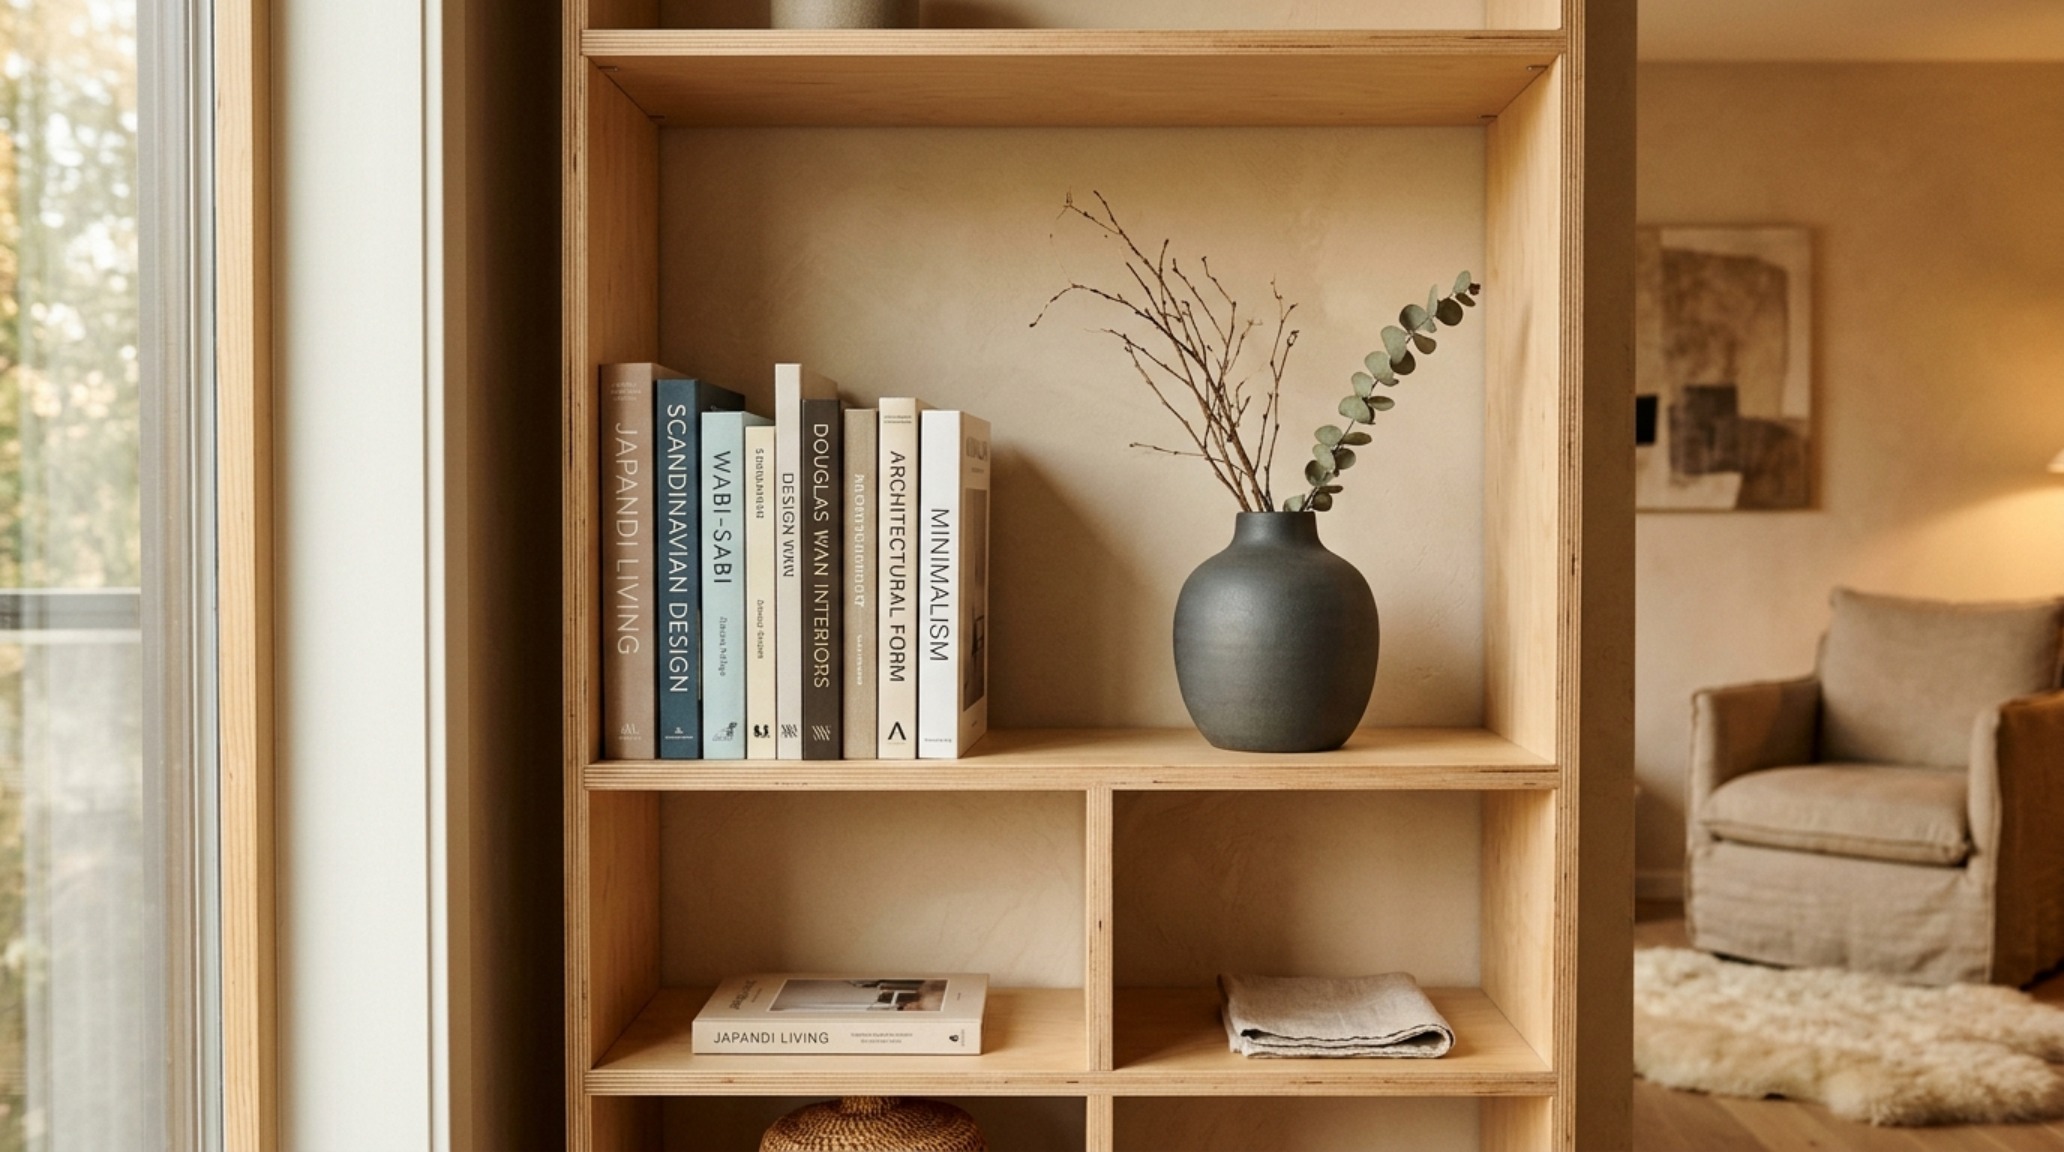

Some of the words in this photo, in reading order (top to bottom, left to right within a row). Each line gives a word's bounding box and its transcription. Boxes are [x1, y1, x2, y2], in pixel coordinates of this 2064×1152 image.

[615, 423, 640, 547] JAPANDI
[667, 404, 688, 593] SCANDINAVIAN
[713, 451, 733, 584] WABI-SABI
[782, 473, 795, 535] DESIGN
[812, 423, 829, 523] DOUGLAS
[889, 450, 906, 618] ARCHITECTURAL
[929, 508, 951, 662] MINIMALISM
[616, 558, 640, 656] LIVING
[668, 602, 689, 693] DESIGN
[813, 584, 830, 689] INTERIORS
[889, 624, 906, 683] FORM
[713, 1031, 775, 1045] JAPANDI
[780, 1031, 829, 1045] LIVING
